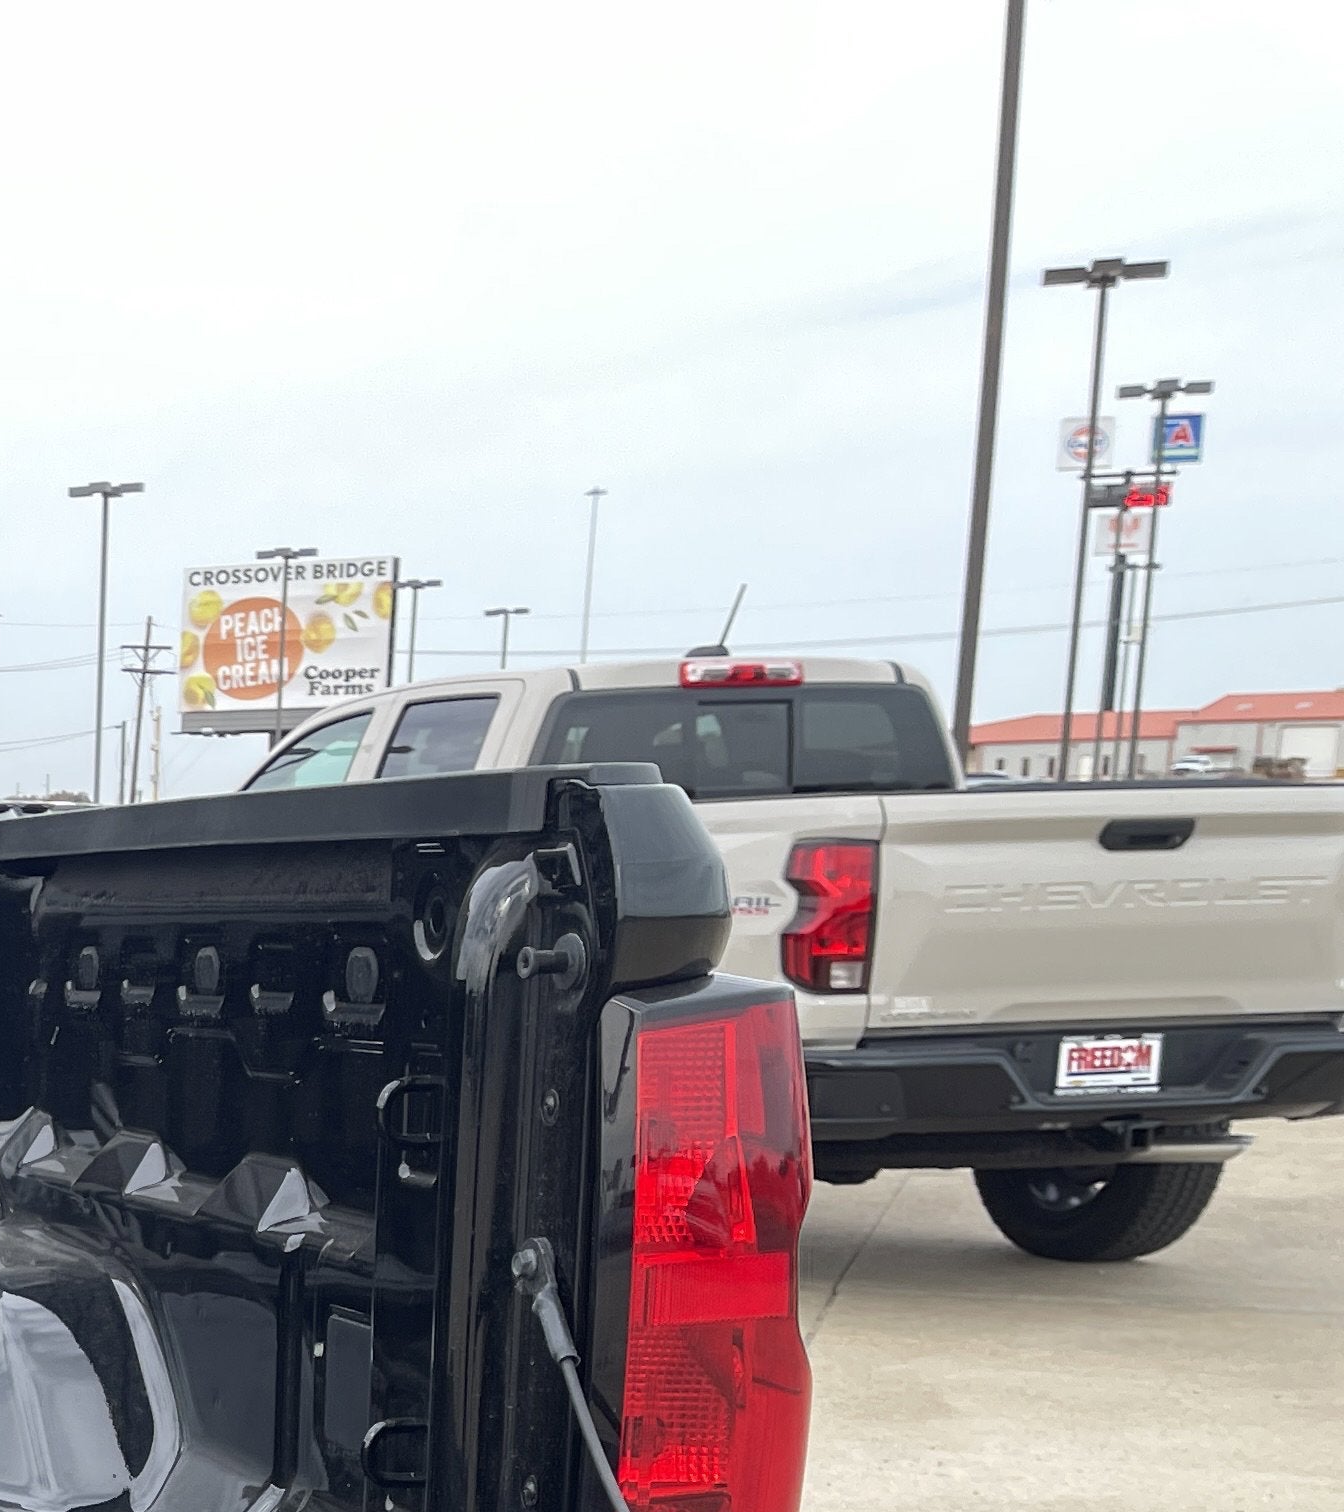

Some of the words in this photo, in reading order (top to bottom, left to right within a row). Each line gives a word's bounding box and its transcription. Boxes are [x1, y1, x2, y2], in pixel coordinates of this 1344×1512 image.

[189, 565, 306, 587] CROSSOVER
[312, 561, 388, 580] BRIDGE
[236, 636, 269, 662] ICE
[217, 656, 289, 691] CREAM
[304, 665, 381, 682] Cooper
[308, 681, 375, 696] Farms
[944, 875, 1328, 914] CHEVROLET
